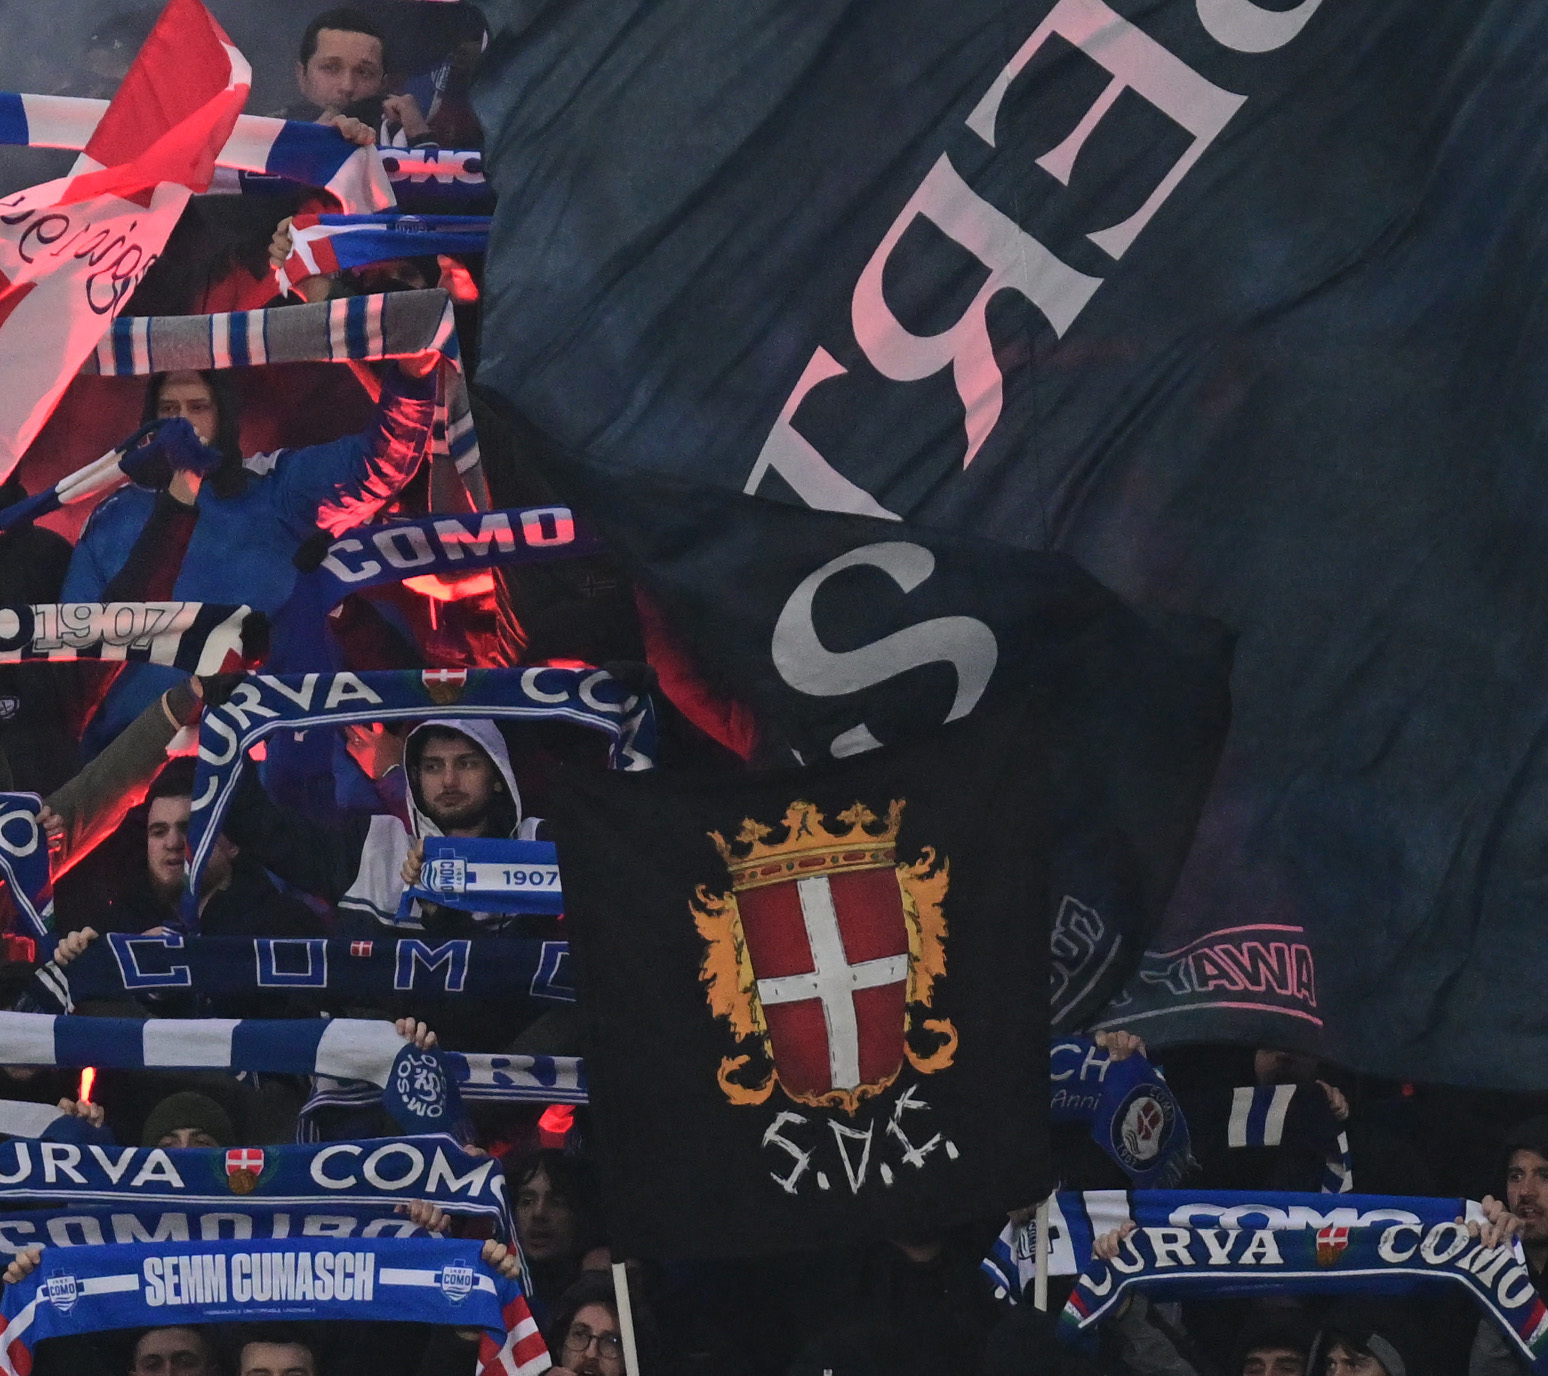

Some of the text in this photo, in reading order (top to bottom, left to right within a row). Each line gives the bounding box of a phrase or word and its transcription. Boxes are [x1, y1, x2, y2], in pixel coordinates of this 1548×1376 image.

[319, 505, 578, 586] COMO
[192, 671, 386, 813] CURVA
[501, 867, 561, 887] 1907
[143, 1251, 375, 1307] SEMM CUMASCH
[1081, 1221, 1535, 1310] CURVA COMO
